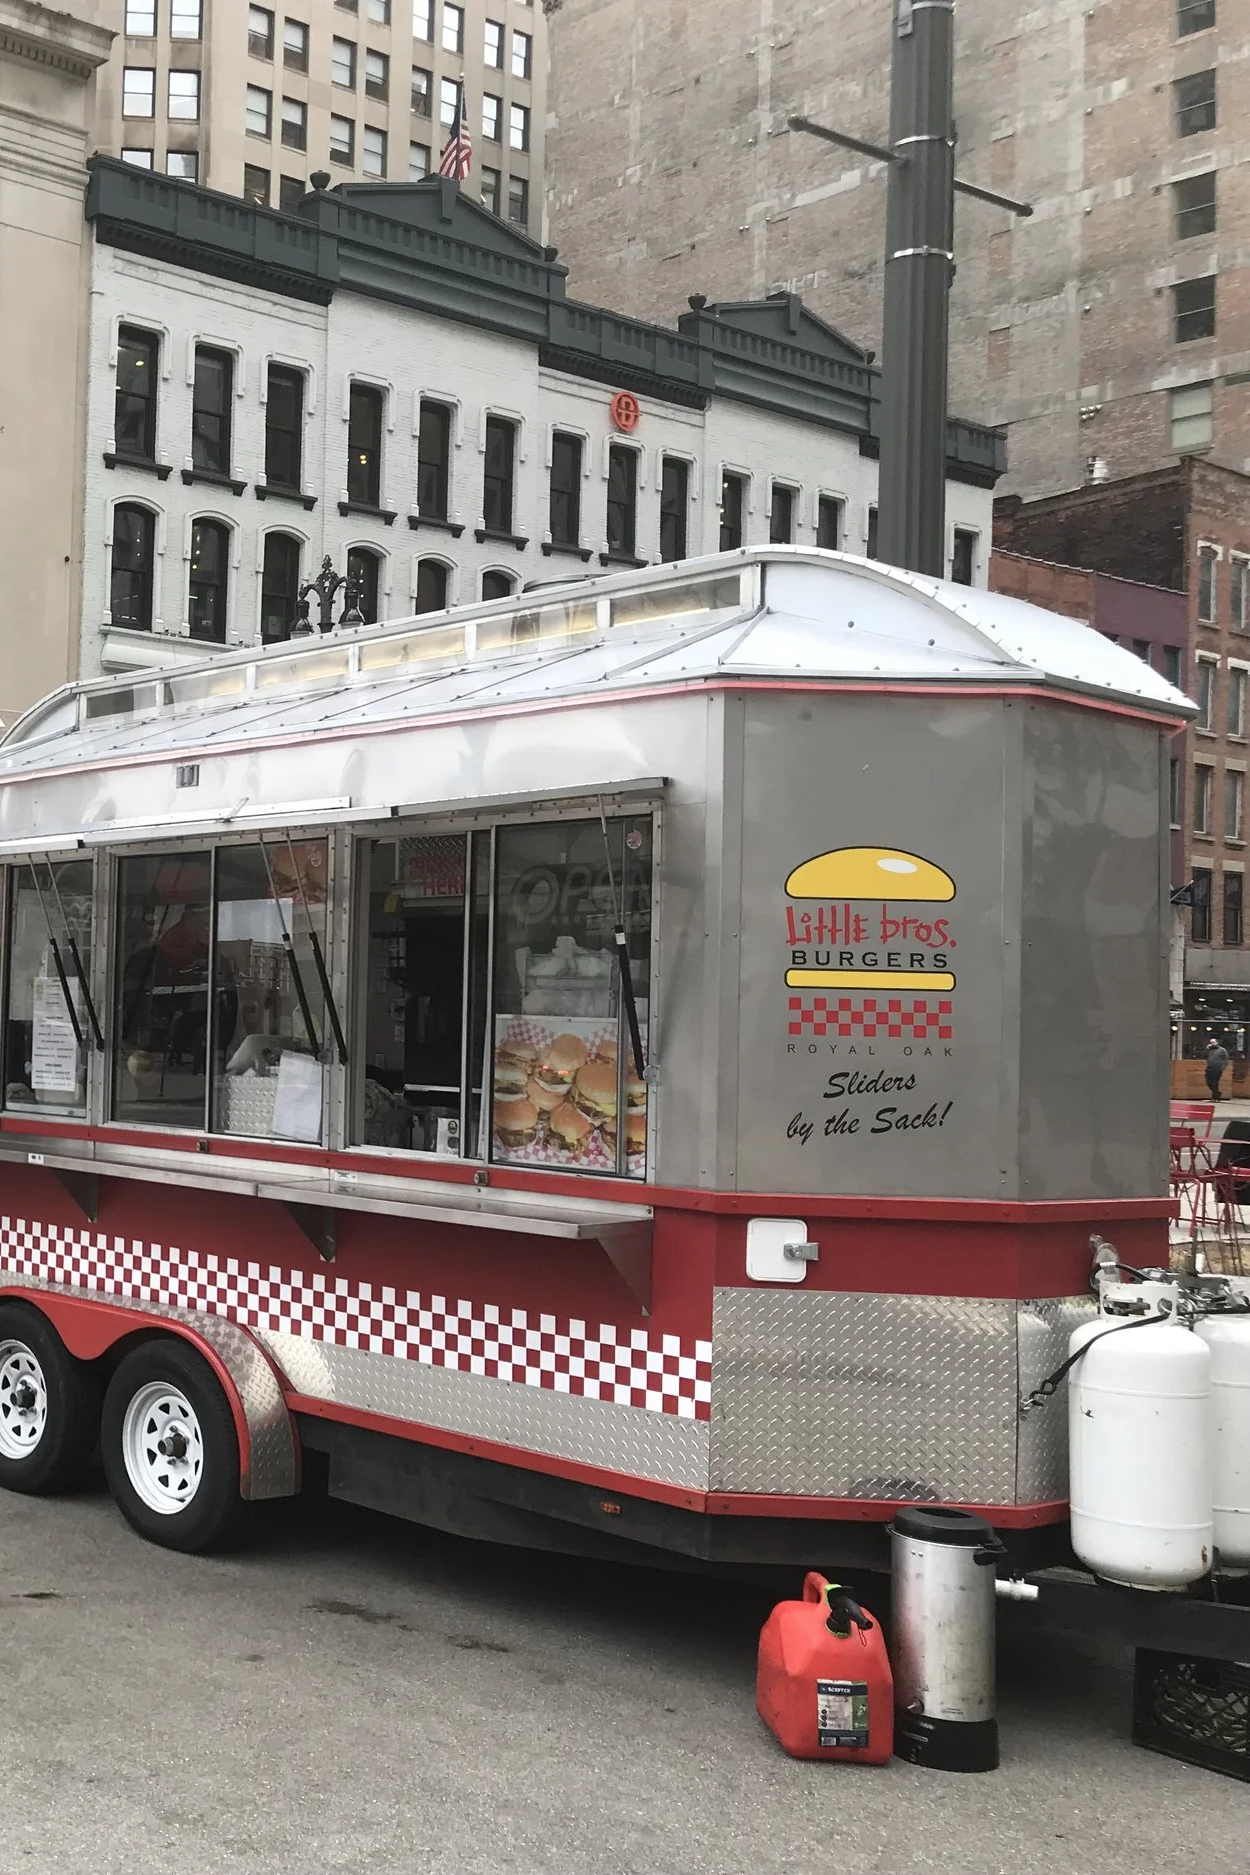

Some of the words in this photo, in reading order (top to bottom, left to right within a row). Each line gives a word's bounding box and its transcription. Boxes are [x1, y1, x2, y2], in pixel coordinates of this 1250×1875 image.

[786, 903, 869, 946] Little
[880, 903, 958, 948] bros.
[791, 950, 948, 969] BURGERS
[787, 1043, 876, 1056] ROYAL
[903, 1046, 953, 1057] OAK
[823, 1069, 917, 1099] Sliders
[786, 1112, 814, 1145] by
[824, 1108, 861, 1137] the
[870, 1101, 954, 1134] Sack!
